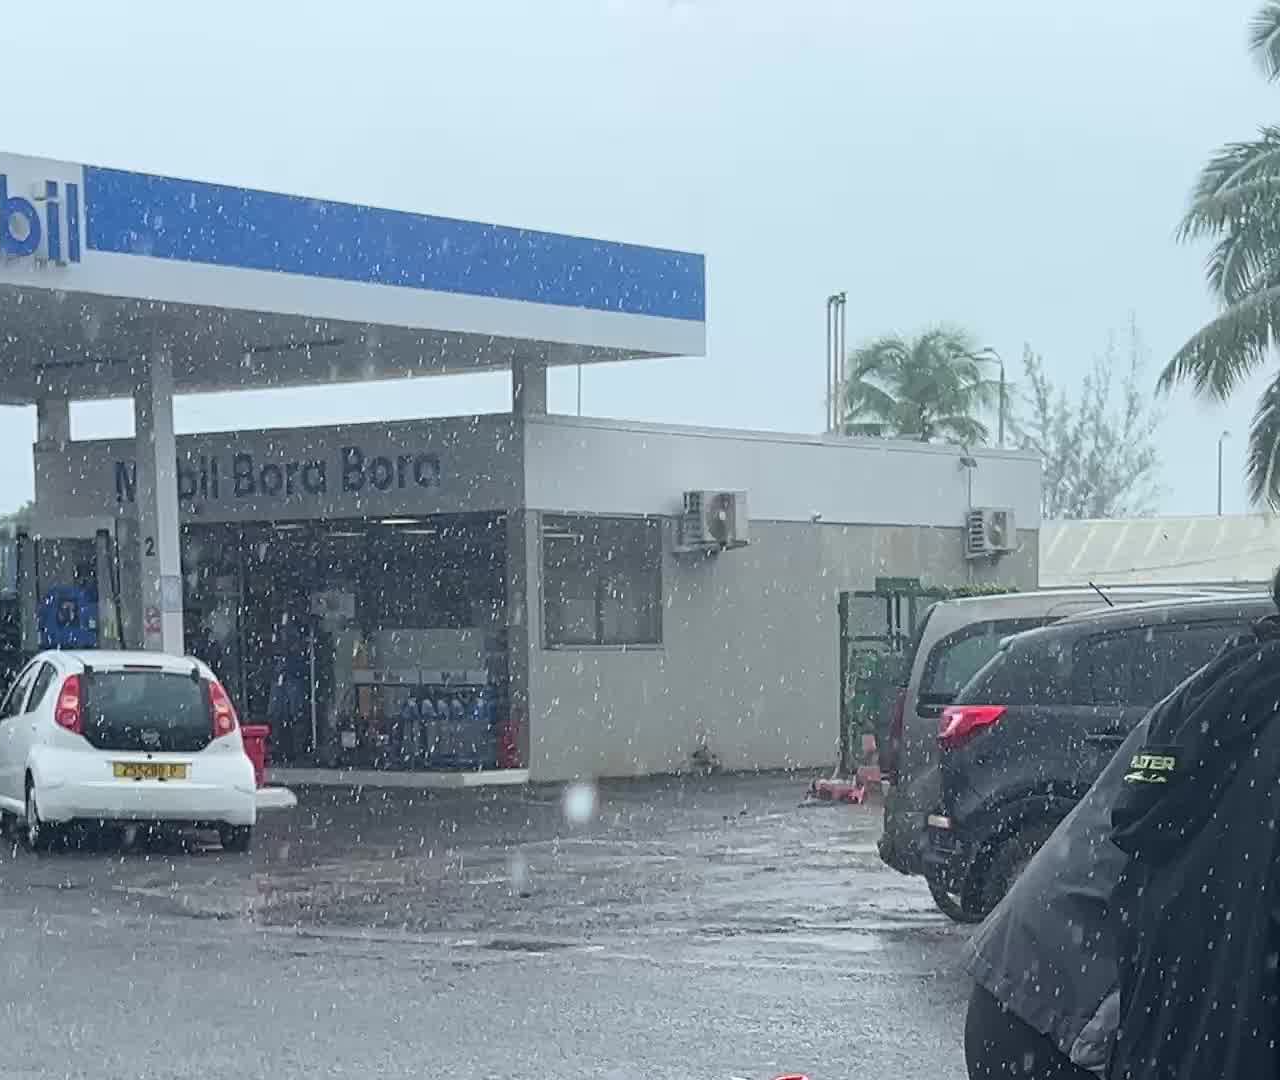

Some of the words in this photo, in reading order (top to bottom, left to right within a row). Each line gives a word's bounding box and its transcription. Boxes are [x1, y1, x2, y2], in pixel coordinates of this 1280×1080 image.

[115, 456, 219, 502] Mbil
[232, 452, 328, 498] Bora
[341, 446, 441, 492] Bora
[144, 536, 156, 557] 2
